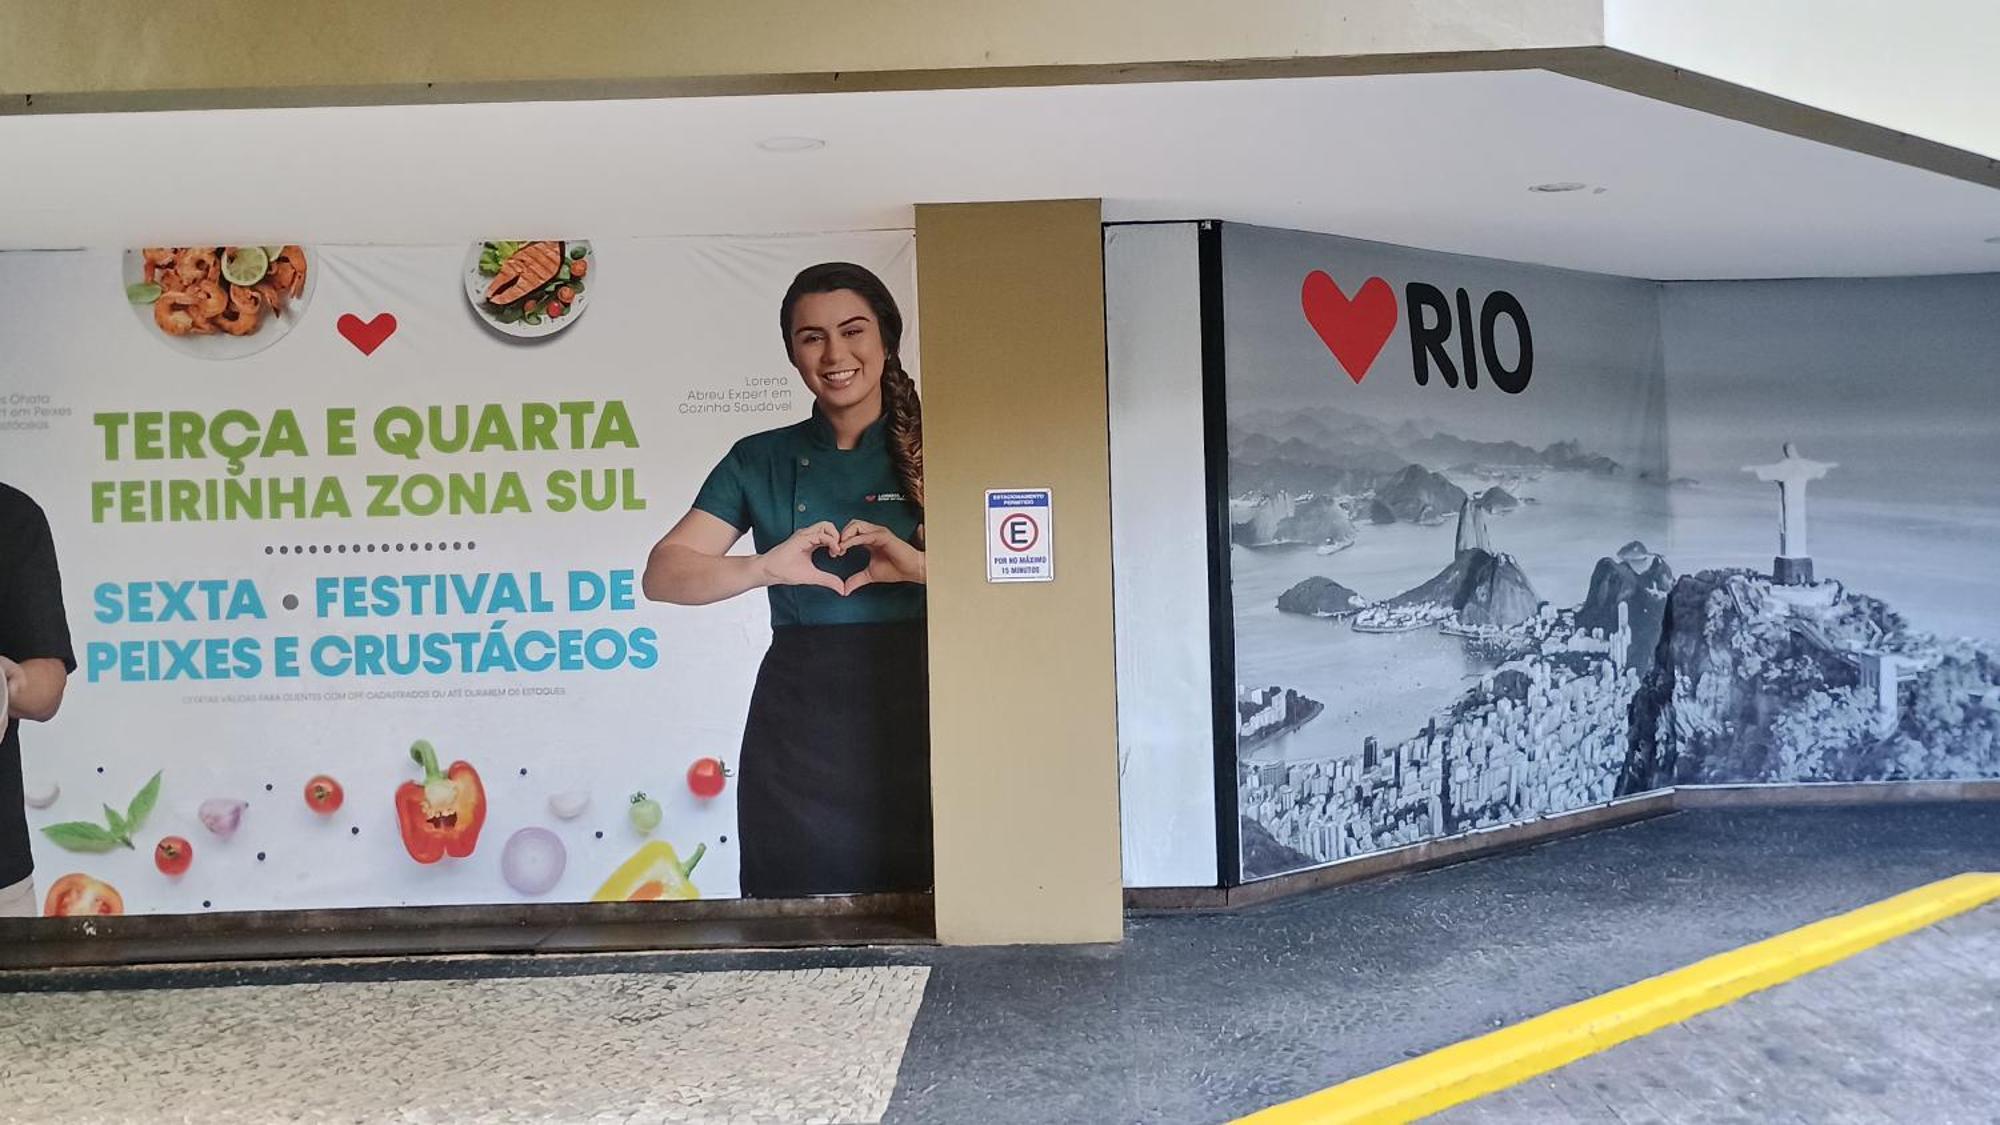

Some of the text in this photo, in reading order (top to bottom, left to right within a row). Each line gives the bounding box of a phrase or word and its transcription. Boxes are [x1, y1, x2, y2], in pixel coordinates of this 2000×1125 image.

[1405, 282, 1534, 394] RIO
[678, 403, 731, 413] Cozinha
[687, 388, 792, 400] Abreu Expert em
[745, 377, 788, 386] Lorena
[95, 400, 639, 475] TERÇA E QUARTA
[92, 468, 647, 523] FEIRINHA ZONA SUL
[1010, 521, 1028, 544] E
[93, 569, 637, 624] SEXTA FESTIVAL DE
[86, 620, 660, 684] PEIXES E CRUSTÁCEOS
